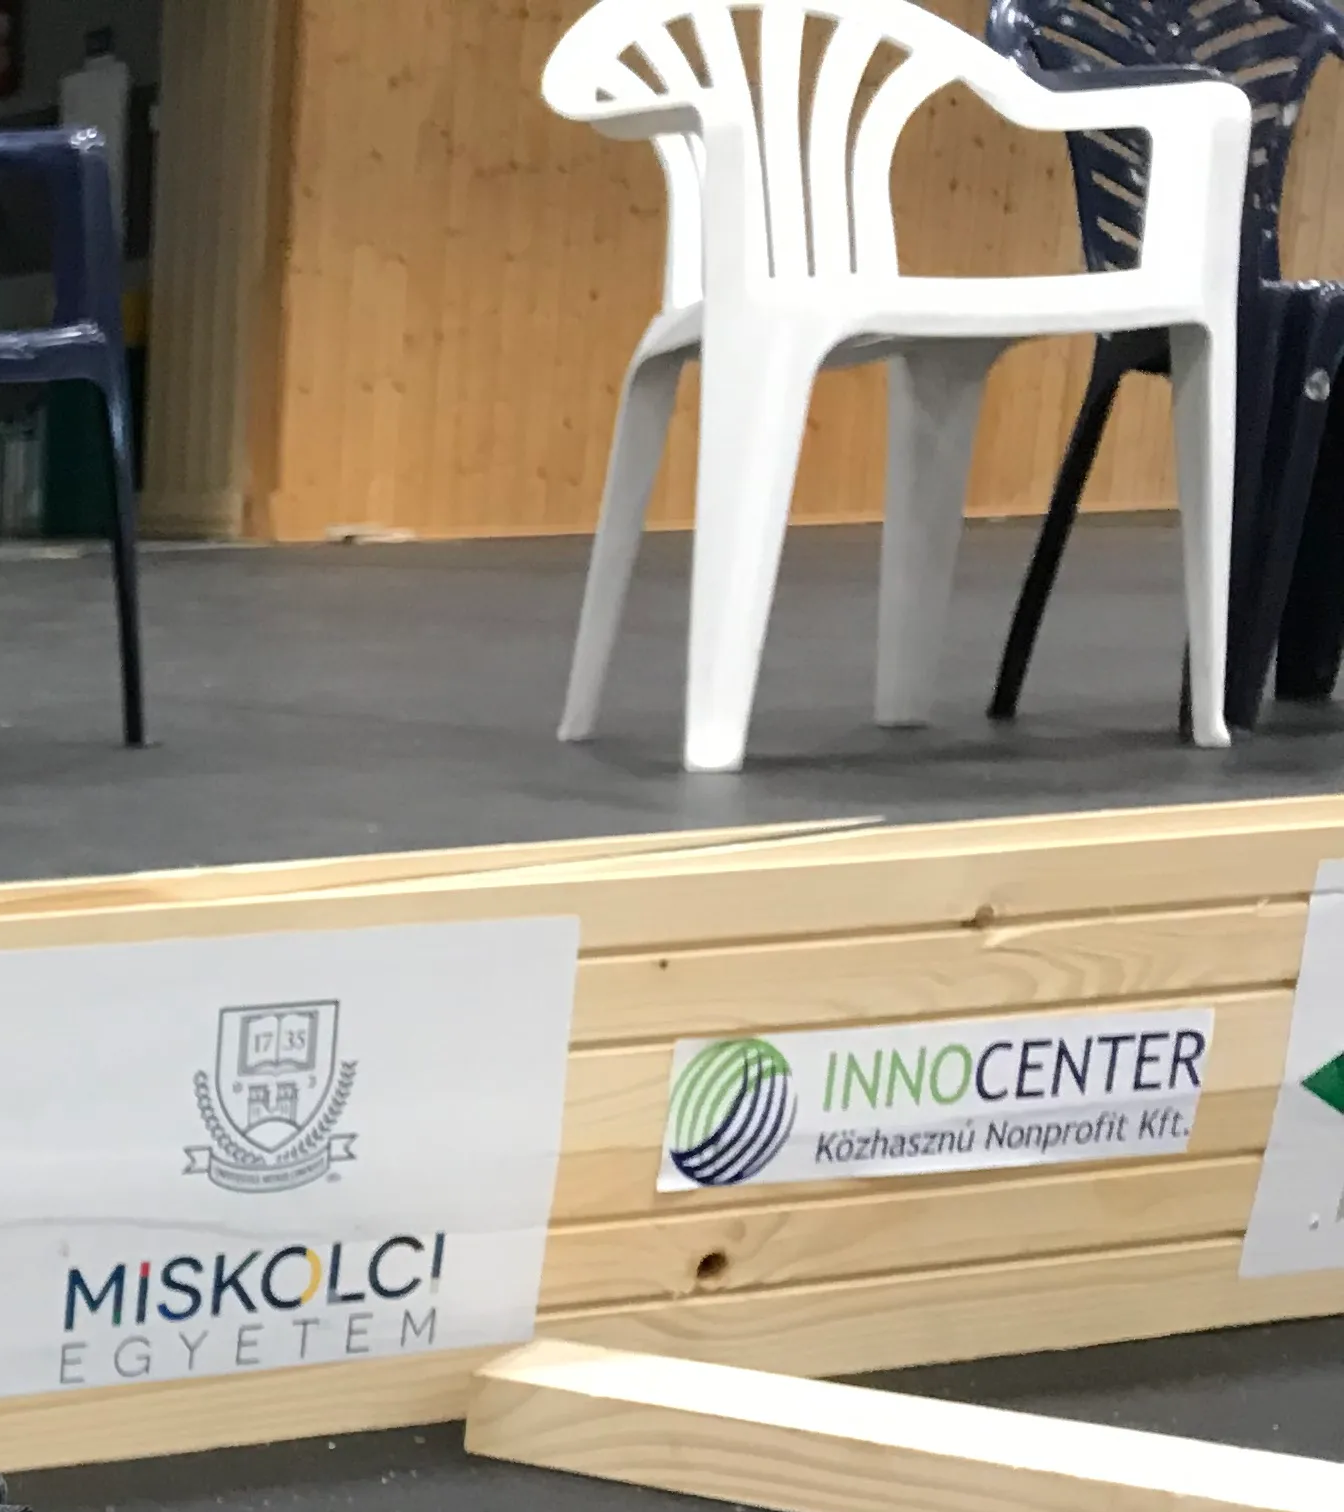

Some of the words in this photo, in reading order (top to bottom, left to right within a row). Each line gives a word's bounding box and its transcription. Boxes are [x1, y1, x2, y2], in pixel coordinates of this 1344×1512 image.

[254, 1031, 274, 1053] 17
[283, 1029, 306, 1051] 35
[820, 1028, 1206, 1112] INNOCENTER
[814, 1117, 976, 1164] Közhasznú
[984, 1109, 1129, 1154] Nonprofit
[1138, 1105, 1190, 1141] Kft.
[63, 1231, 446, 1332] MISKOLCI
[59, 1307, 438, 1385] EGYETEM
